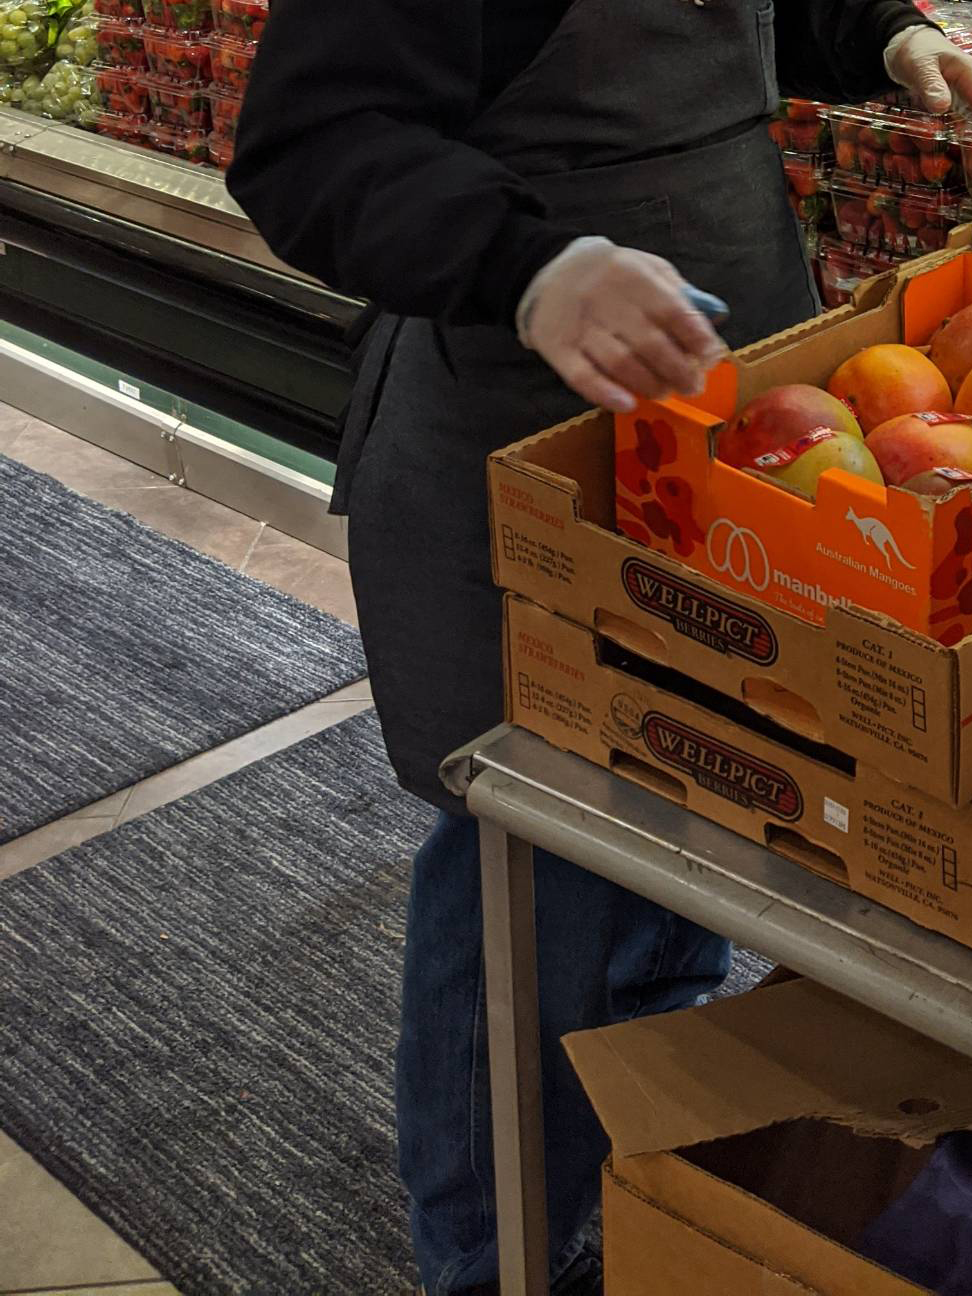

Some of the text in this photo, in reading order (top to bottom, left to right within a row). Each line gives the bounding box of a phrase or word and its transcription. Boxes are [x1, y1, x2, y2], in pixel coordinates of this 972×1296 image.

[773, 568, 858, 610] manbull
[815, 542, 918, 596] Australian Mangoes
[675, 618, 727, 654] BERRIES
[836, 640, 923, 685] PRODUCE OF MEXICO
[697, 773, 750, 806] BERRIES
[863, 799, 904, 822] PRODUCE
[905, 817, 916, 827] OF
[918, 824, 954, 845] MEXICO
